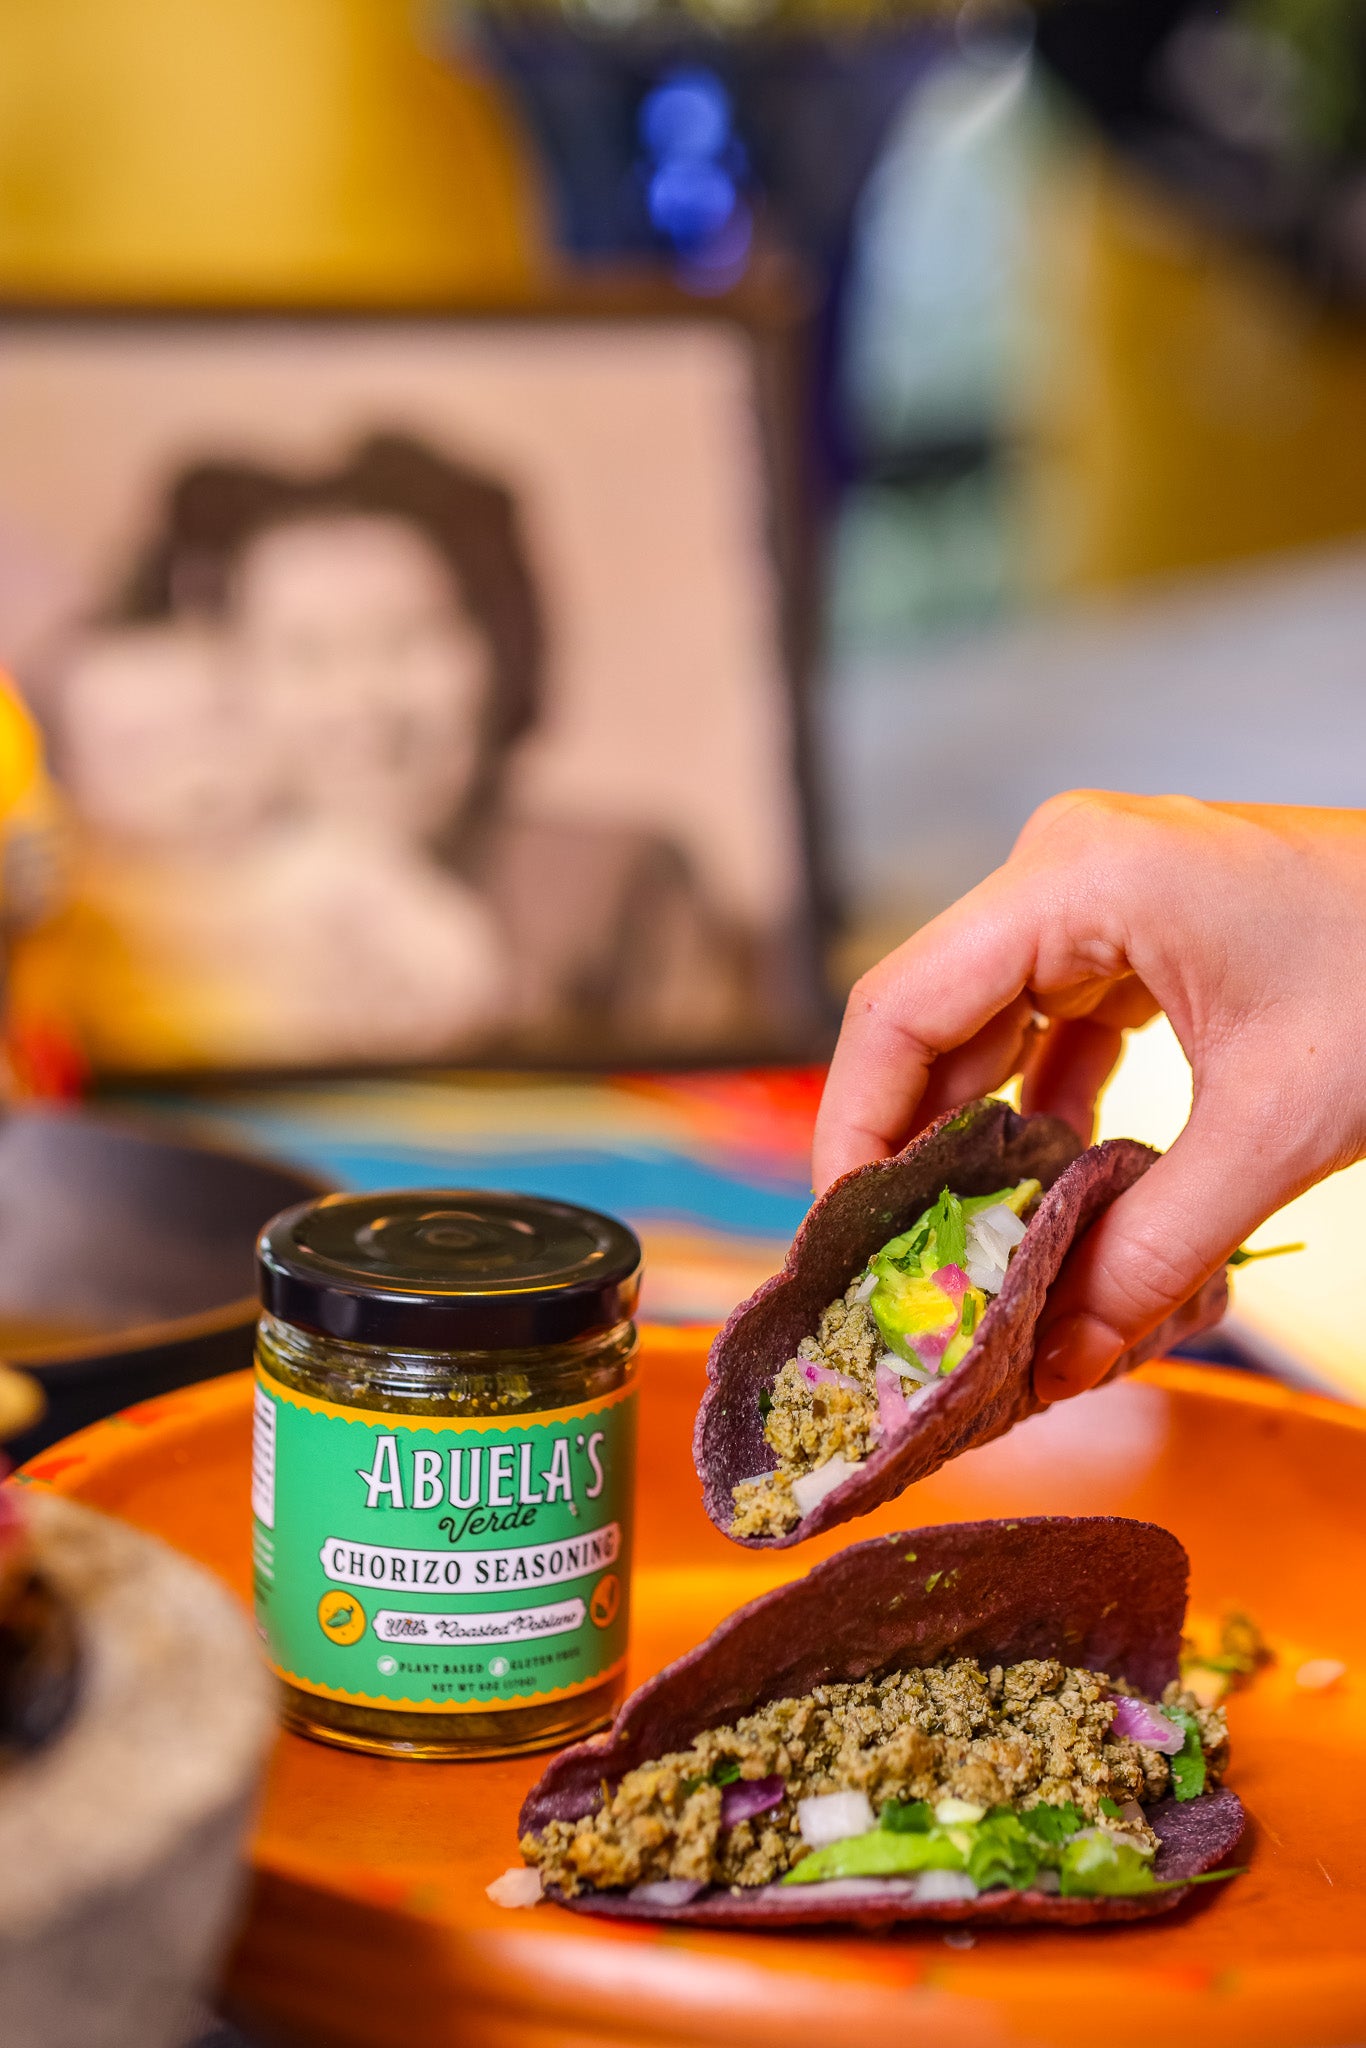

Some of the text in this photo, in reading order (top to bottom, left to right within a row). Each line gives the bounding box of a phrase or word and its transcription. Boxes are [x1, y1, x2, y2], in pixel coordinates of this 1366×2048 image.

[438, 1503, 537, 1543] Verde
[332, 1530, 615, 1585] CHORIZO SEASONING
[435, 1619, 510, 1638] Roasted
[400, 1662, 439, 1675] PLANT
[443, 1663, 485, 1675] BASED
[432, 1682, 452, 1692] NET
[458, 1682, 475, 1692] WT
